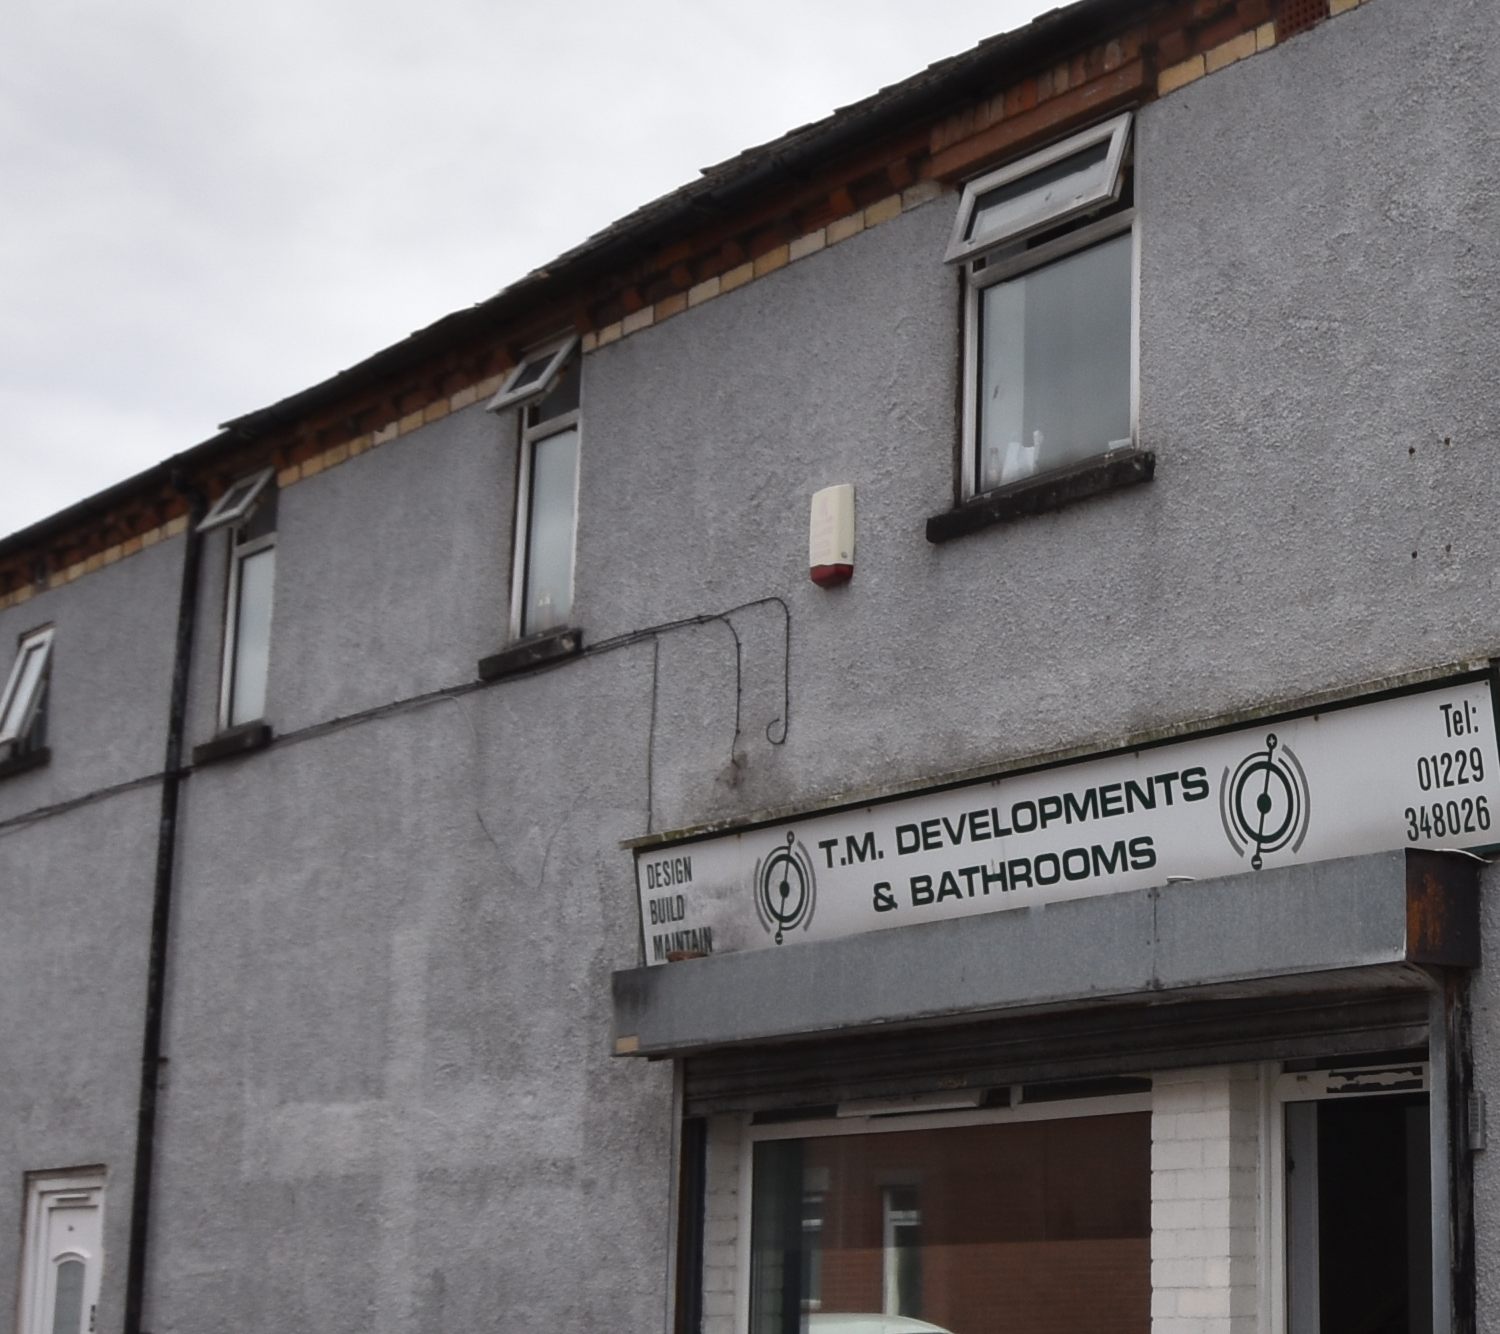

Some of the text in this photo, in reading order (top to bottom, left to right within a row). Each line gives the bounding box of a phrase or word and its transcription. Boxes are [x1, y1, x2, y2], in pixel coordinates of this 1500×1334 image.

[1439, 700, 1479, 738] Tel:
[1417, 747, 1484, 791] 01229
[818, 766, 1209, 868] T.M. DEVELOPMENTS
[1404, 795, 1491, 841] 348026
[647, 856, 692, 889] DESIGN
[873, 835, 1157, 912] & BATHROOMS
[650, 895, 685, 925] BUILD
